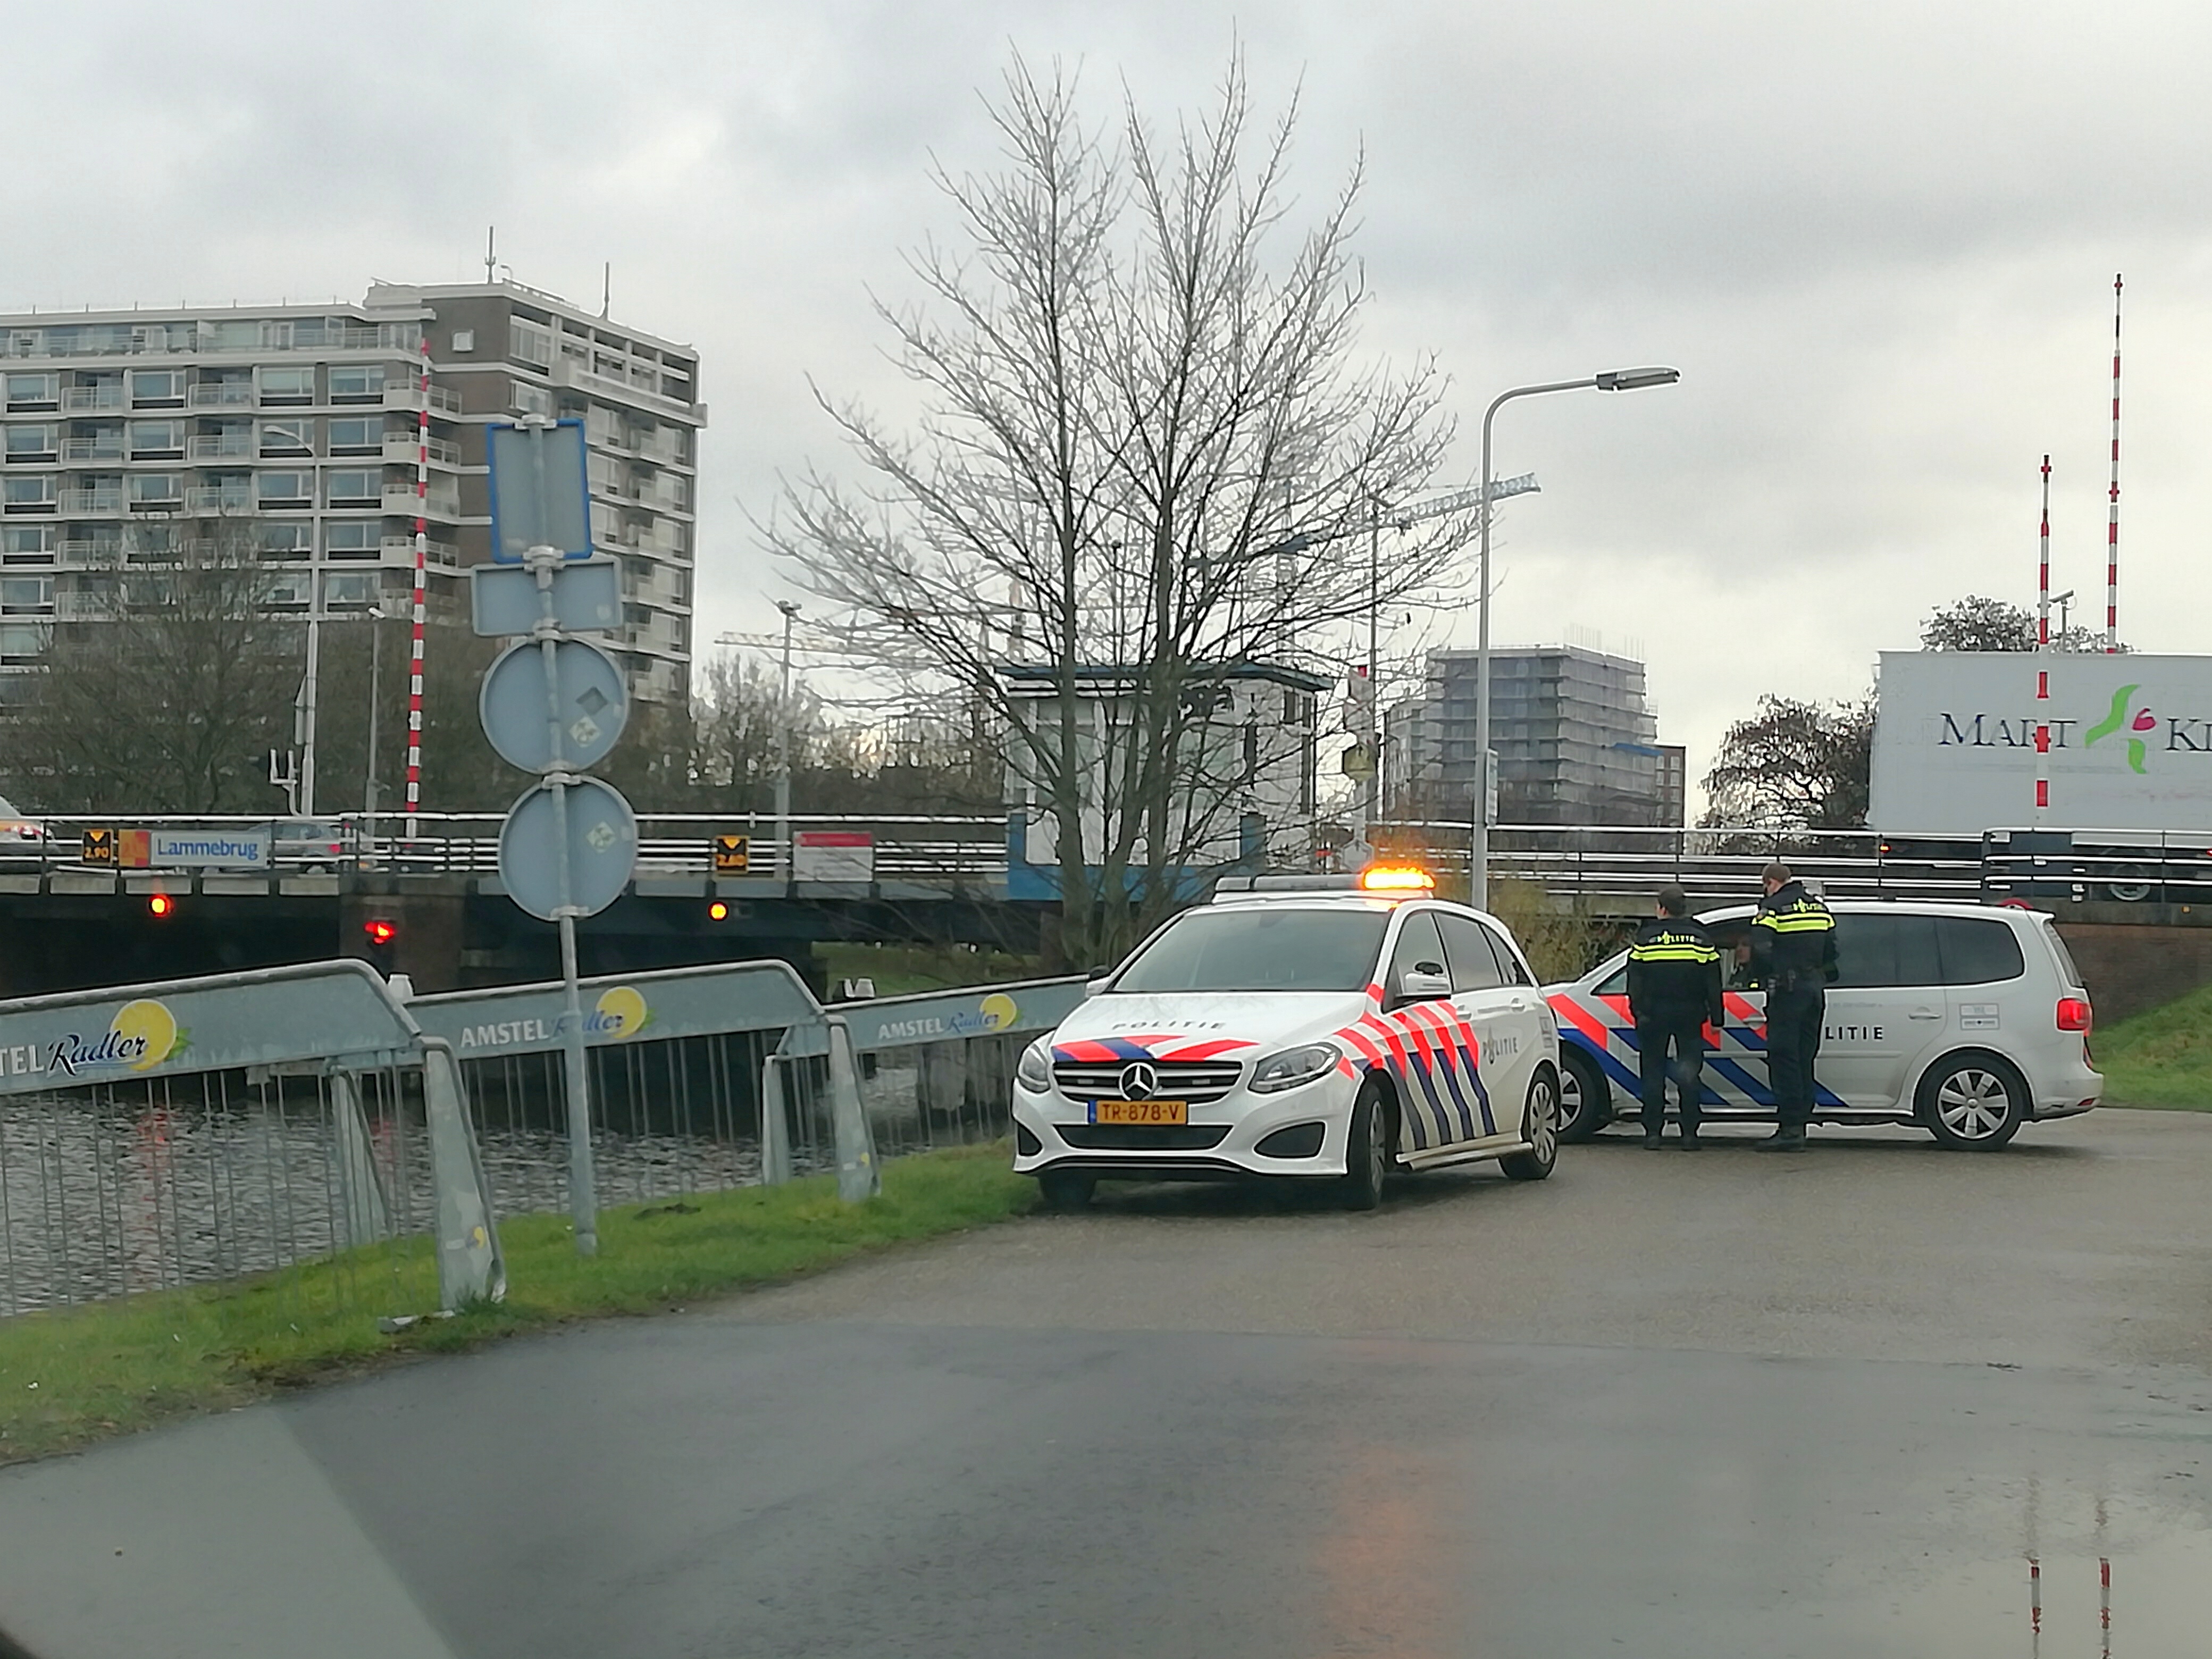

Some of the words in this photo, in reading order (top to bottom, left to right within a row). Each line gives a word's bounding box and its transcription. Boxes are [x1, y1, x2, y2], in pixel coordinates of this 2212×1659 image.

[157, 838, 258, 861] Lammebrug
[460, 1019, 549, 1048] AMSTEL
[878, 1017, 944, 1040] AMSTEL
[1111, 1020, 1225, 1030] POLITIE
[47, 1029, 147, 1077] Radler
[1102, 1104, 1179, 1121] TR-878-V
